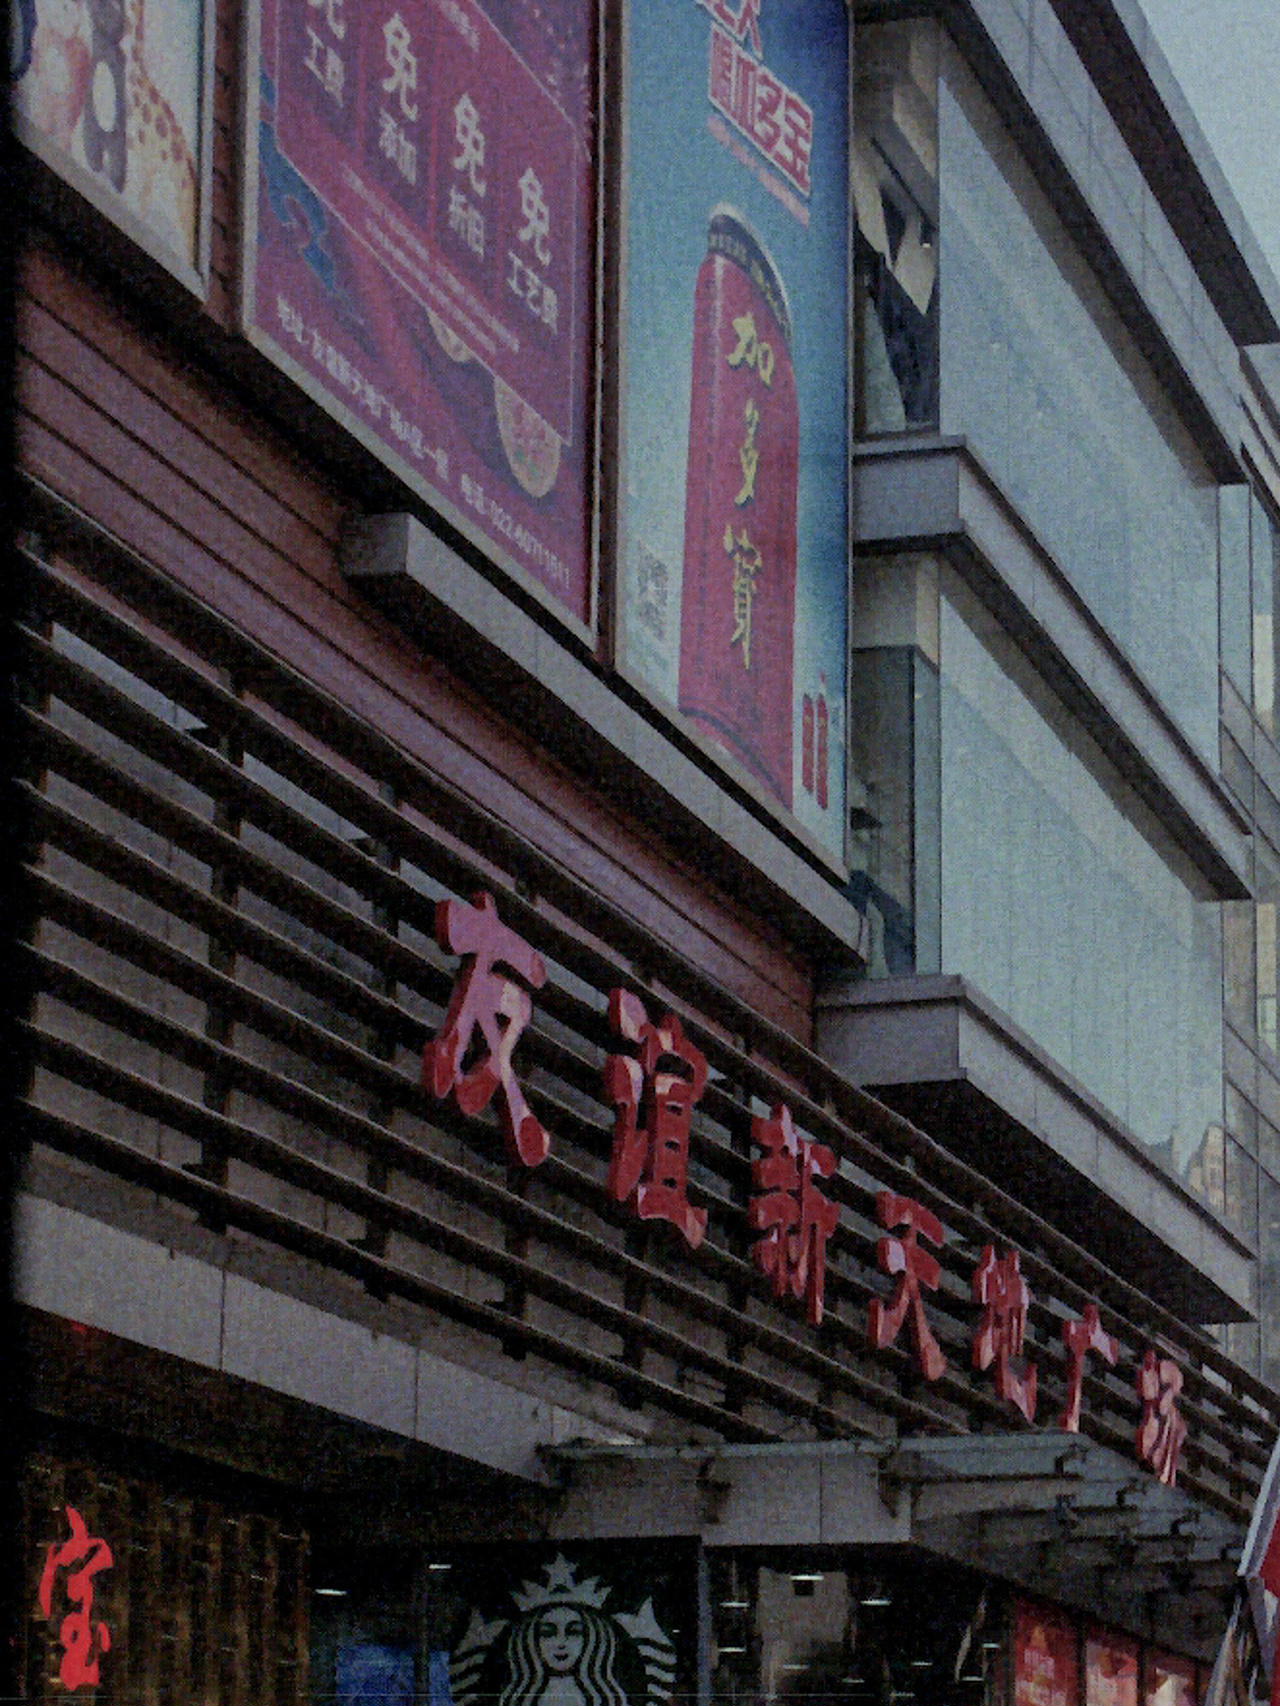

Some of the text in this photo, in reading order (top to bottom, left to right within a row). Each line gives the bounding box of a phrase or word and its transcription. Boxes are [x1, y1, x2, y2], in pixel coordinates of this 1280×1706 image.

[383, 12, 419, 122] 免
[453, 92, 487, 198] 免
[517, 167, 551, 267] 免
